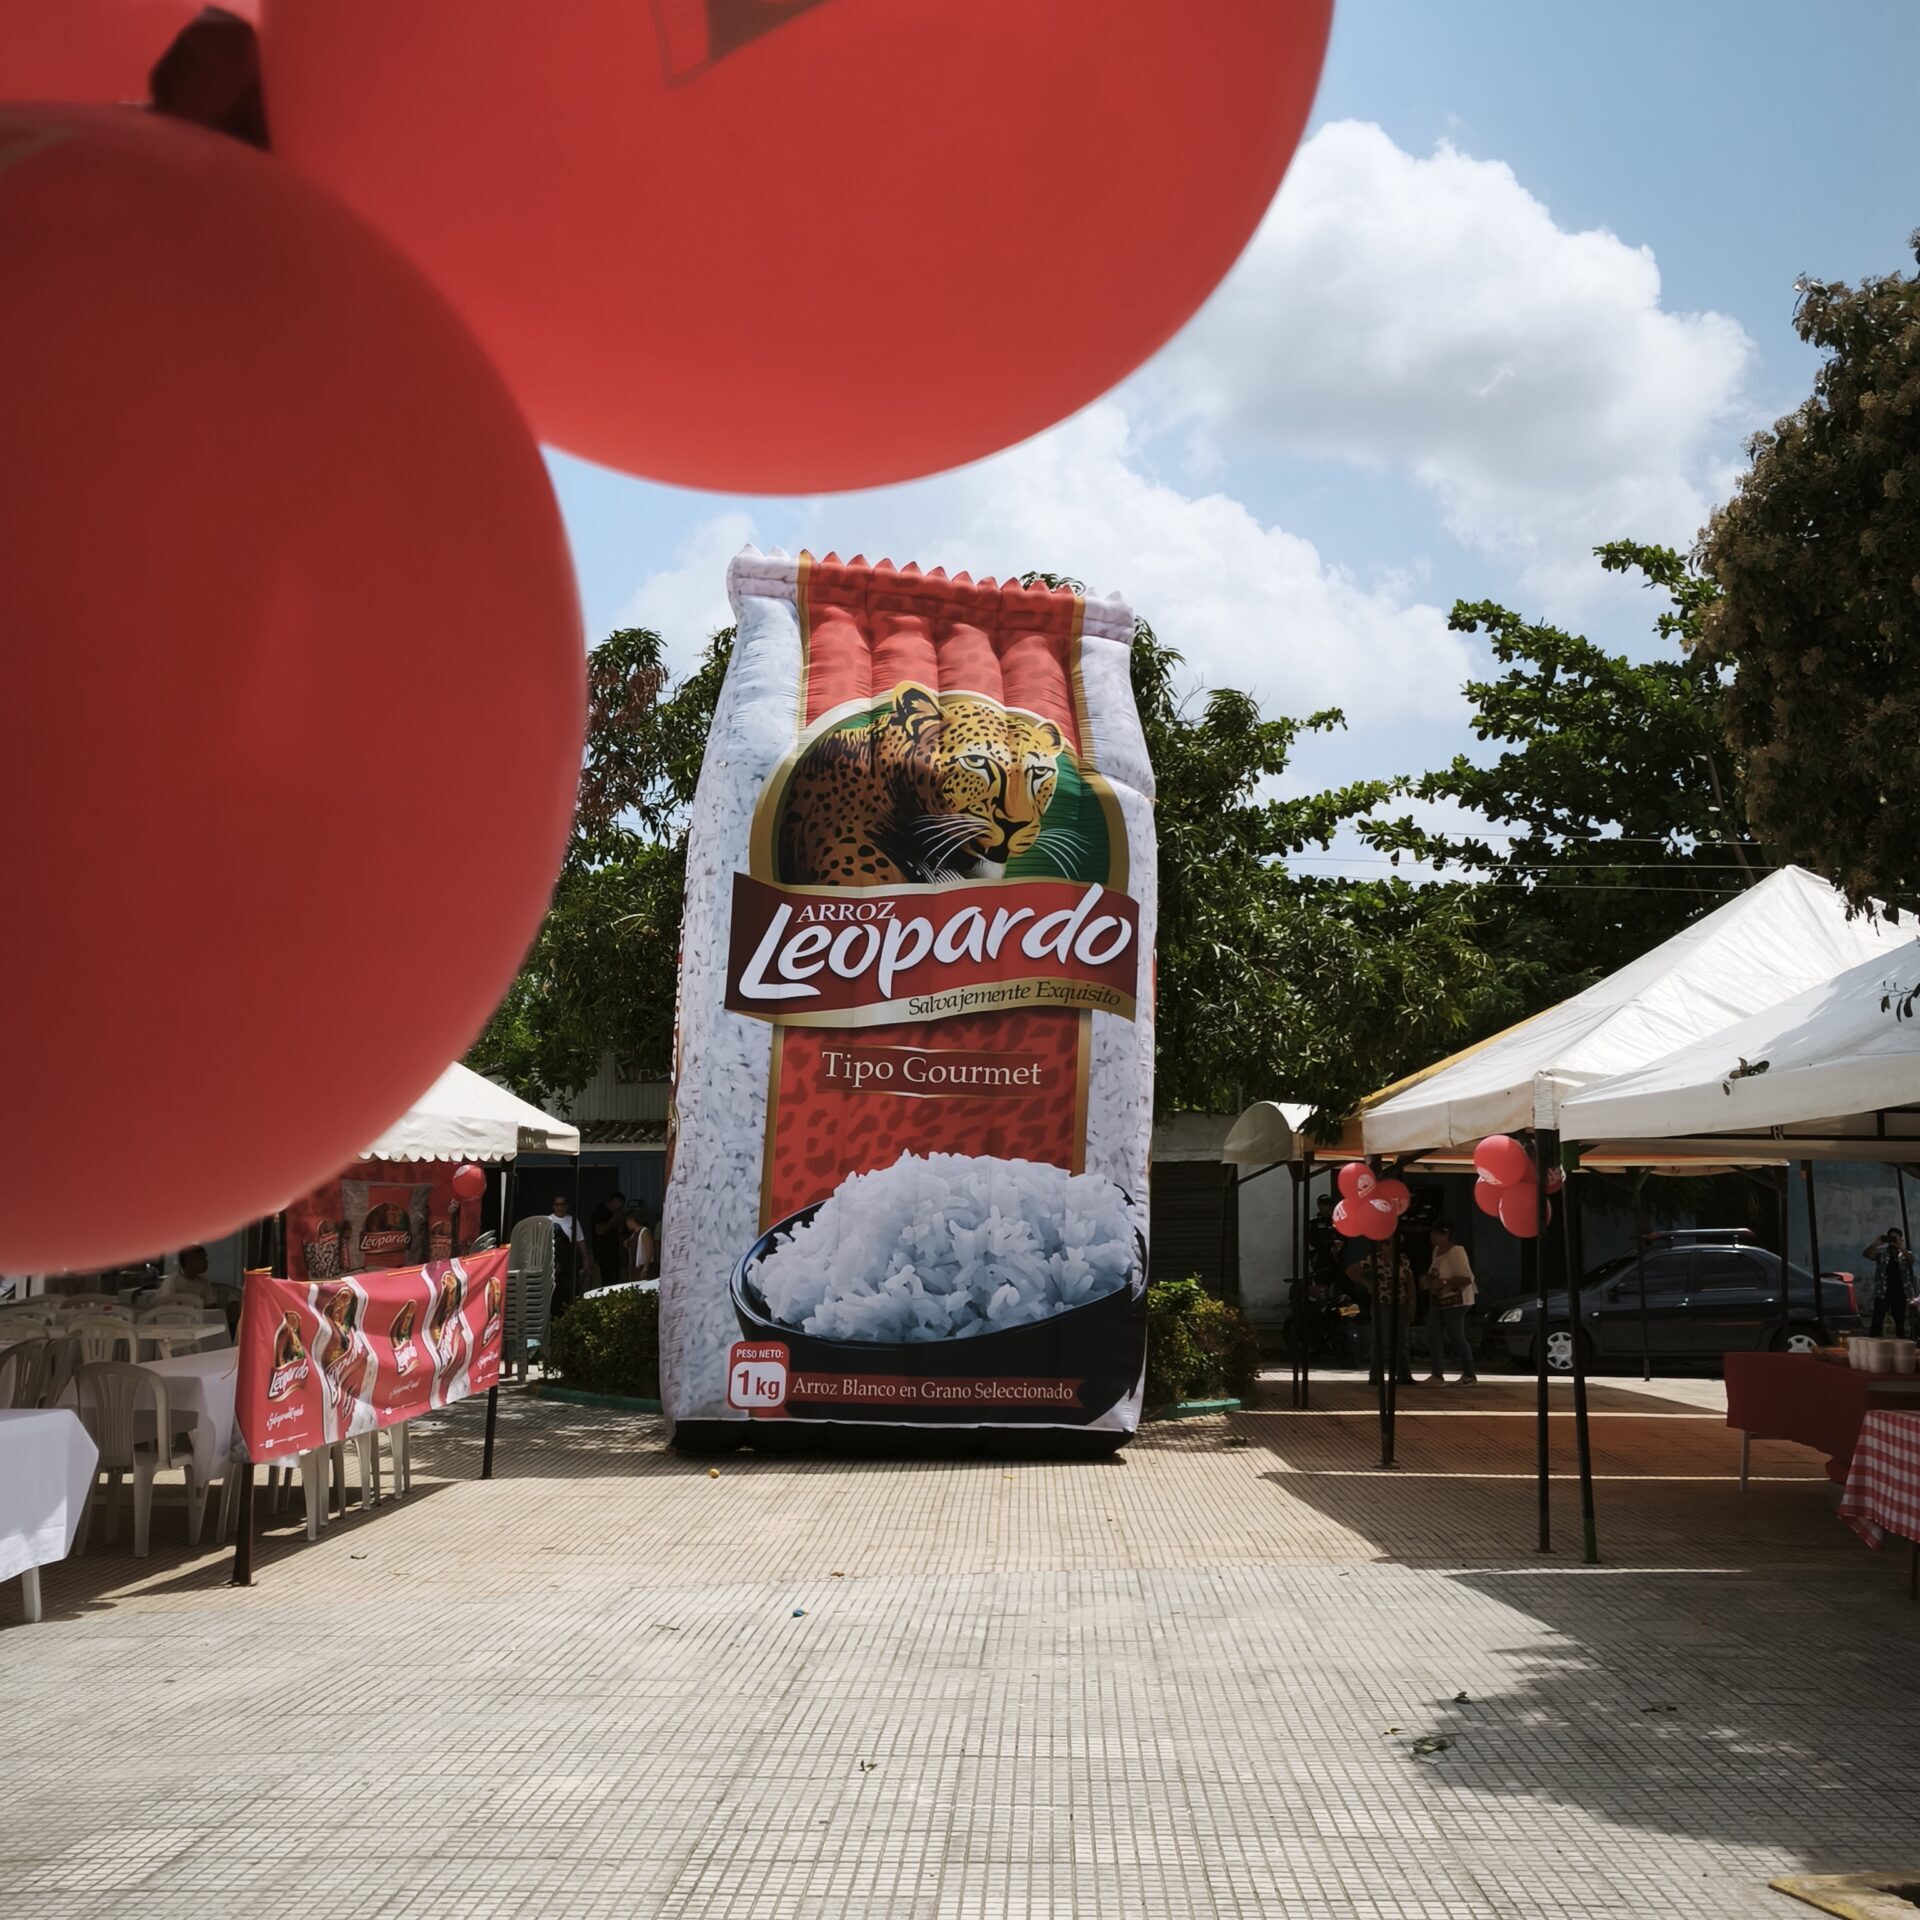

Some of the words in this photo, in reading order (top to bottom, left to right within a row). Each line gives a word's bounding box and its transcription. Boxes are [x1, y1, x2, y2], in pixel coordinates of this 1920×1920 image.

[796, 900, 896, 924] ARROZ
[738, 882, 1133, 1000] Leopardo
[908, 983, 1032, 1016] Salvajemente
[1035, 980, 1121, 1008] Exquisito
[821, 1051, 894, 1088] Tipo
[903, 1056, 1042, 1086] Gourmet
[360, 1231, 412, 1250] Leopardo
[736, 1348, 758, 1359] PESO
[758, 1349, 785, 1360] NETO:
[792, 1377, 838, 1396] Arroz
[842, 1378, 896, 1397] Blanco
[899, 1385, 917, 1398] en
[920, 1381, 972, 1399] Grano
[974, 1382, 1073, 1400] Seleccionado
